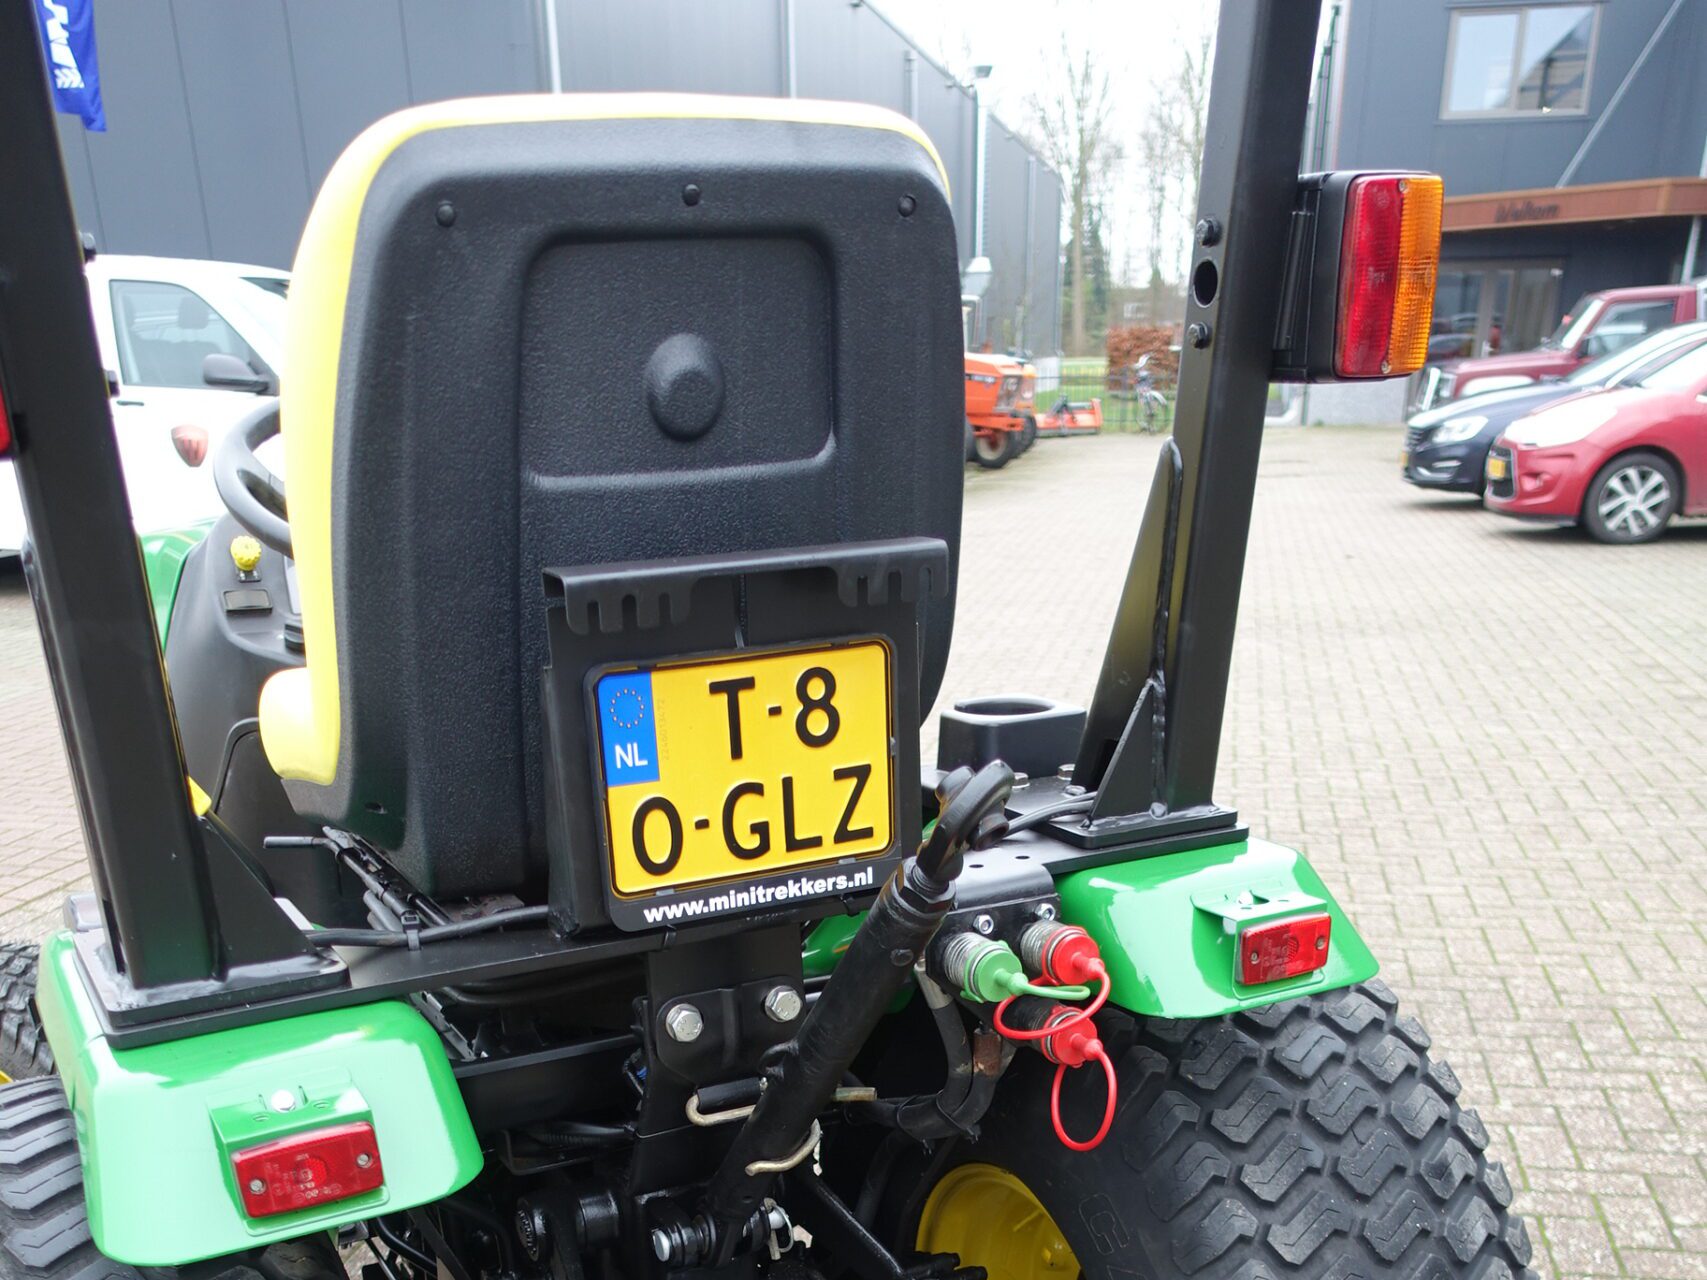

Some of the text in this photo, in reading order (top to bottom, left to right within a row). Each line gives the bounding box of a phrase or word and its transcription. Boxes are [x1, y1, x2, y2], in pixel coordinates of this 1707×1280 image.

[709, 667, 840, 761] T-8
[615, 742, 649, 769] NL
[643, 866, 874, 924] www.minitrekkers.nl
